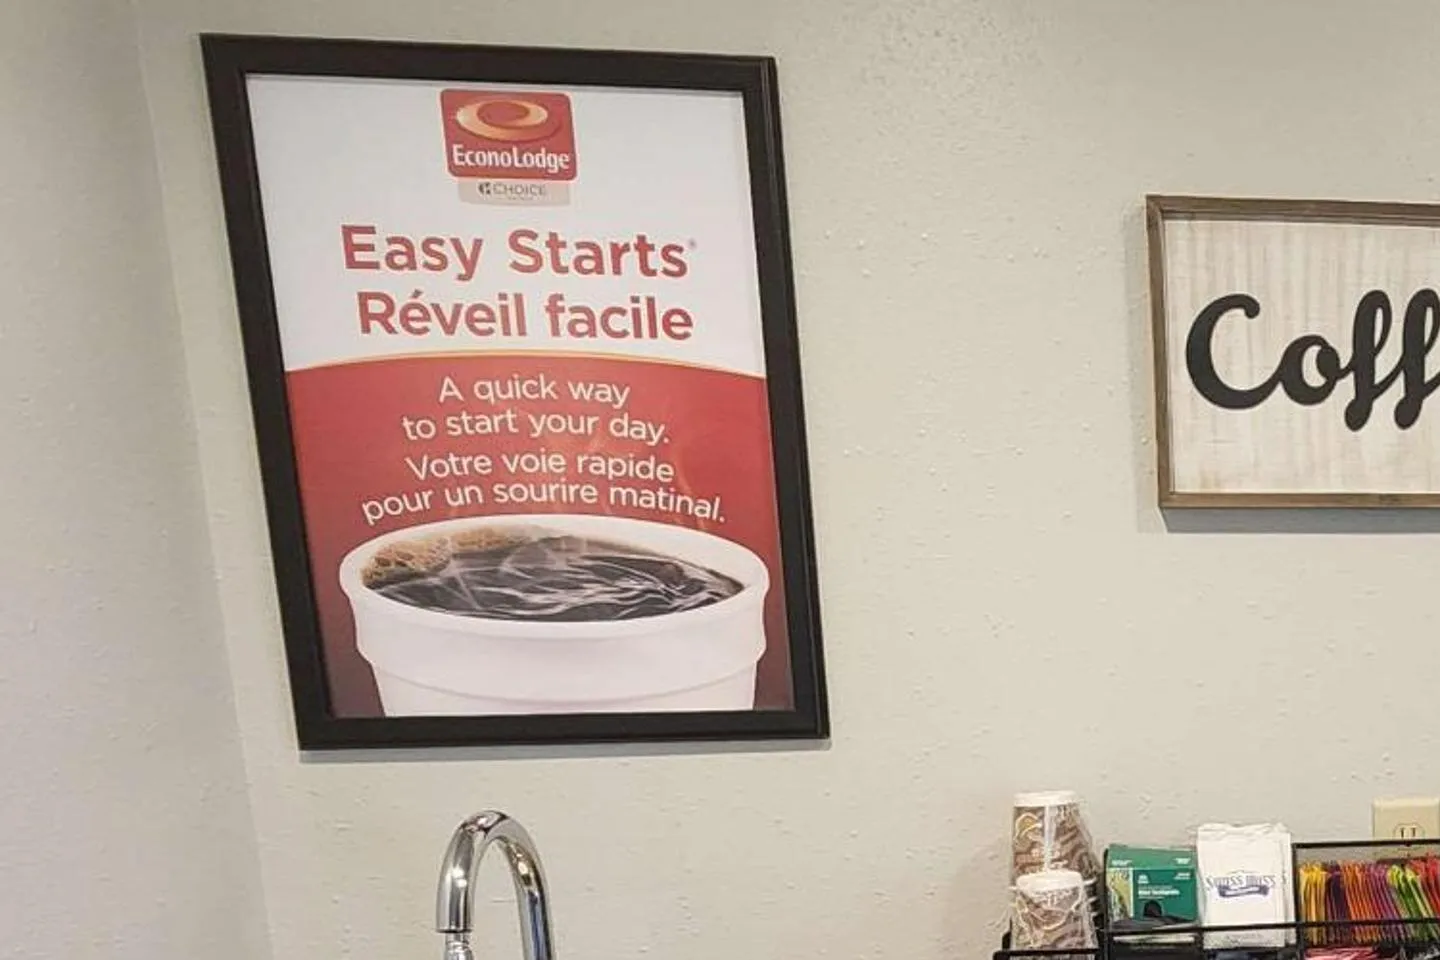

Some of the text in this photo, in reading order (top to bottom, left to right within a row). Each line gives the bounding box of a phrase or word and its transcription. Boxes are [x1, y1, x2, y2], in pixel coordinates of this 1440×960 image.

[452, 143, 571, 174] EconoLodge
[341, 224, 688, 281] Easy Starts
[357, 288, 694, 340] Réveil facile
[438, 372, 631, 409] A quick way
[401, 408, 671, 447] to start your day.
[404, 447, 675, 483] Votre voie rapide
[361, 477, 727, 527] pour un sourire matinal.
